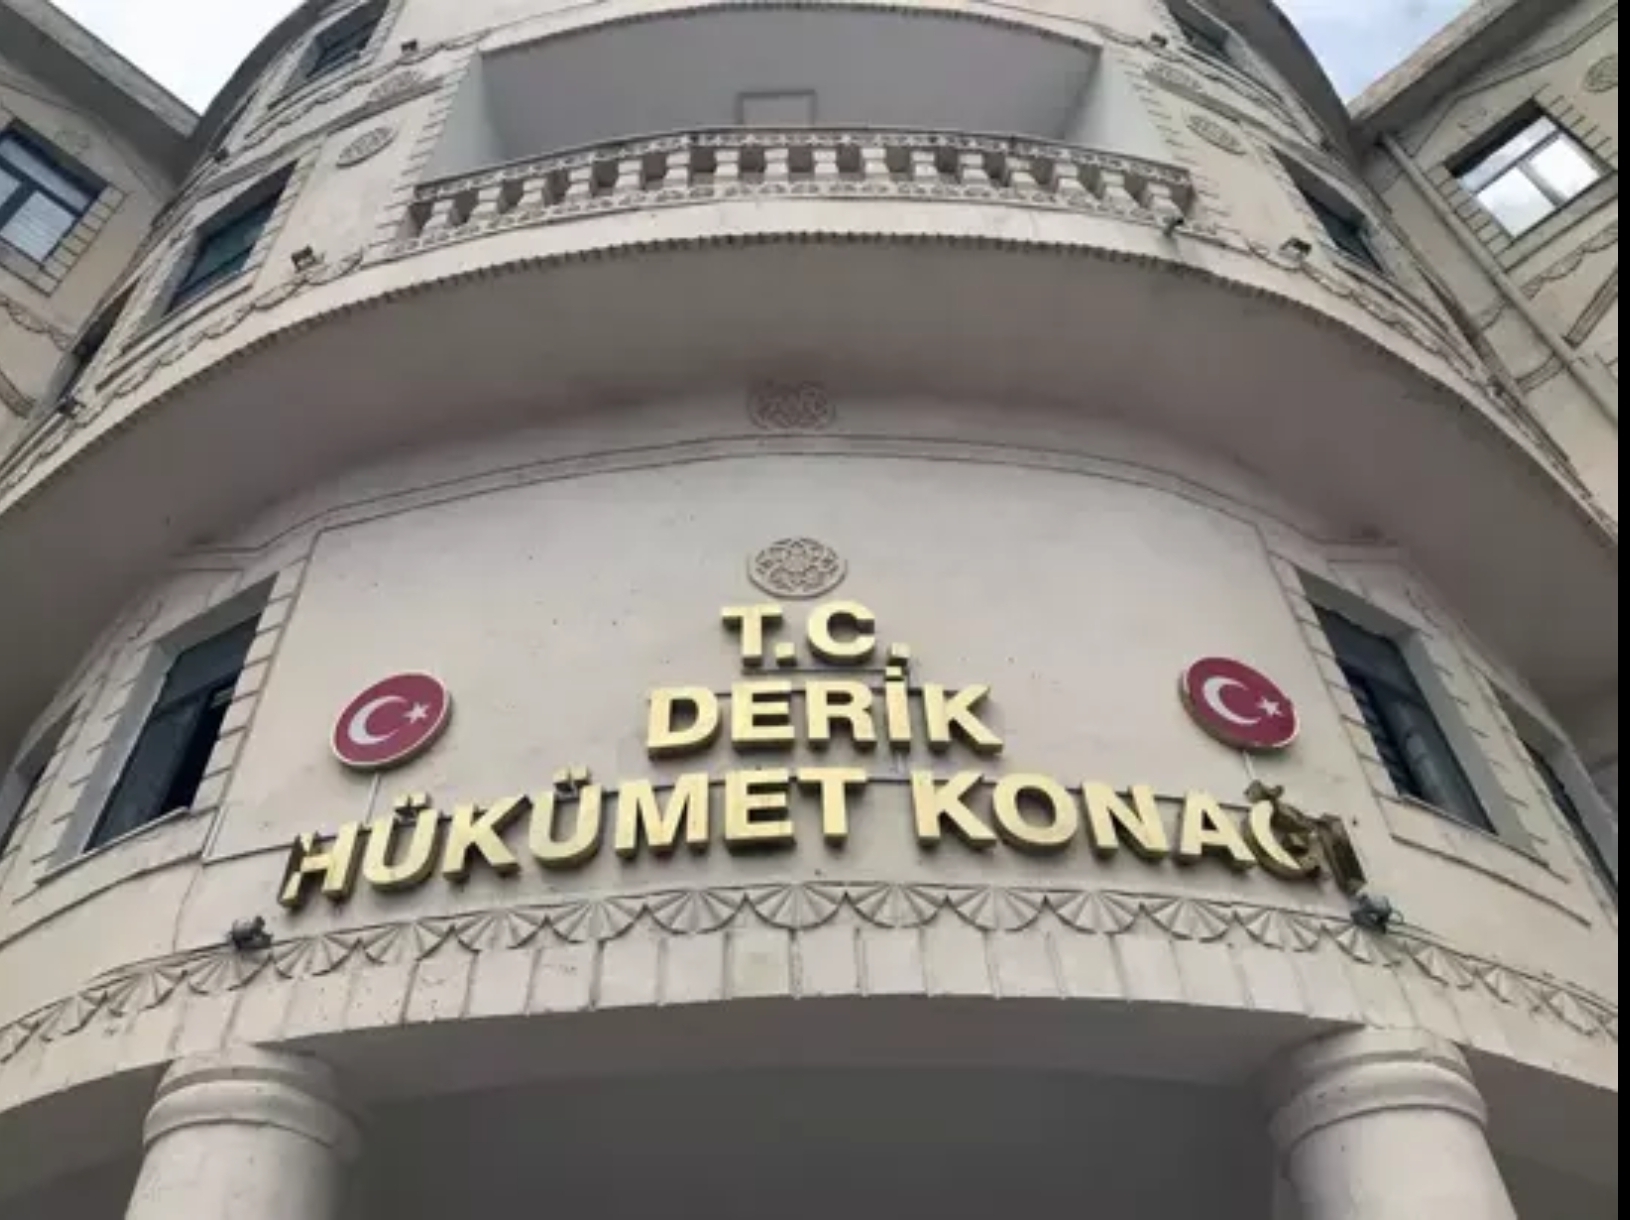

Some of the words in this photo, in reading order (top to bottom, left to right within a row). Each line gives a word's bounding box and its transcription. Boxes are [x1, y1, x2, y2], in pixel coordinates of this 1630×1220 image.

[720, 600, 910, 668] T.C.
[646, 665, 1004, 758] DERİK
[278, 765, 868, 906] HÜKÜMET
